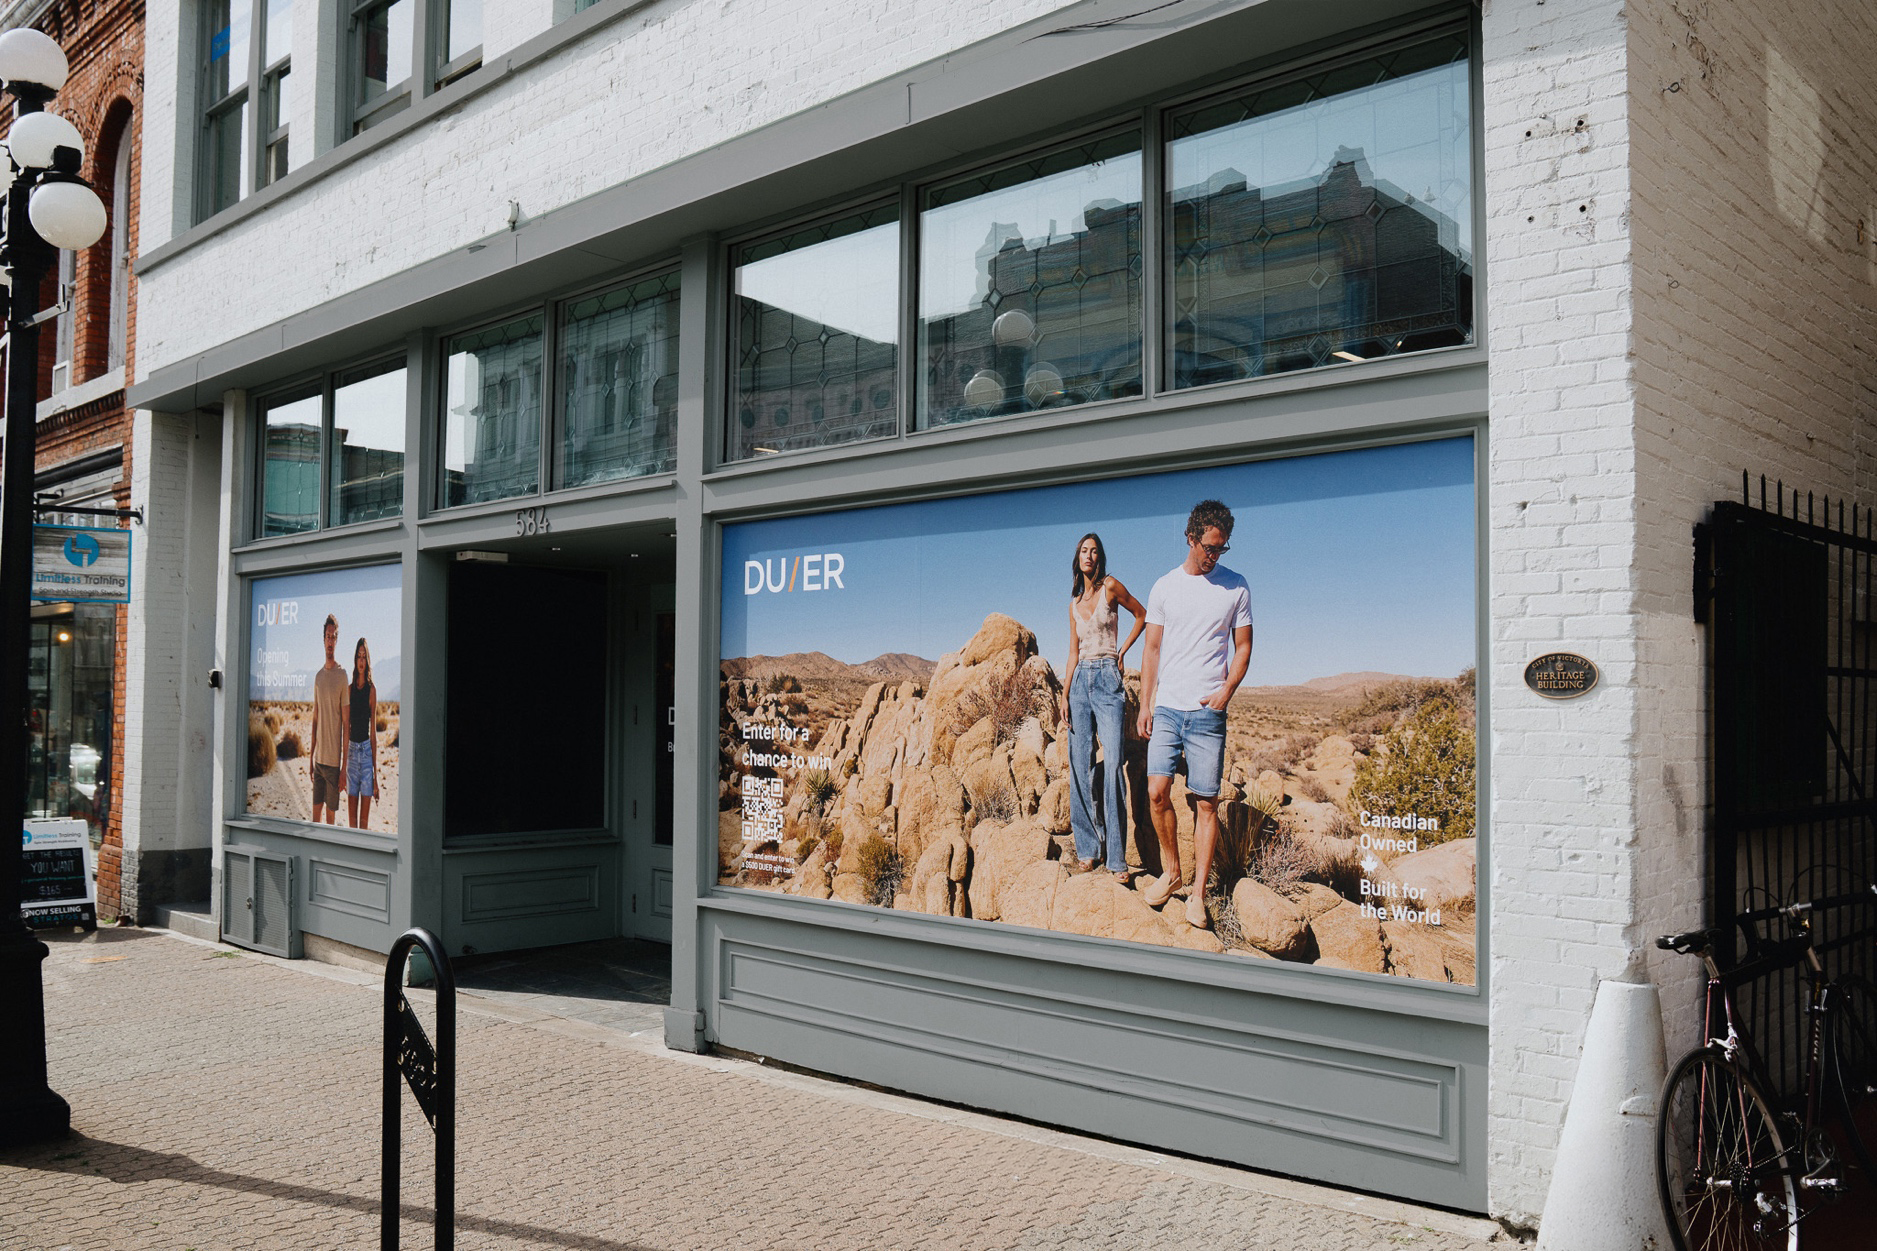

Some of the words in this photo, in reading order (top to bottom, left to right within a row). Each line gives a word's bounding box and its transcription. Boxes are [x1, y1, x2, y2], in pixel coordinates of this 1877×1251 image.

[515, 506, 550, 536] 584
[35, 572, 81, 584] Limitless
[84, 575, 126, 587] Training
[257, 647, 289, 667] Opening
[1531, 658, 1546, 669] CITY
[1557, 655, 1589, 669] VICTORIA
[256, 671, 272, 687] this
[272, 672, 307, 687] Summer
[1536, 671, 1585, 680] HERITAGE
[1537, 681, 1584, 689] BUILDING
[742, 721, 776, 740] Enter
[779, 723, 799, 741] for
[801, 727, 809, 741] a
[742, 749, 788, 768] chance
[790, 752, 805, 769] to
[807, 752, 832, 770] win
[1360, 811, 1438, 830] Canadian
[1360, 833, 1417, 853] Owned
[741, 850, 754, 858] Scan
[30, 861, 49, 874] YOU
[50, 860, 75, 873] WANT
[774, 864, 782, 874] gift
[1360, 879, 1398, 898] Built
[1402, 882, 1428, 900] for
[50, 906, 81, 914] SELLING
[1360, 902, 1387, 920] the
[1391, 904, 1441, 925] World
[33, 914, 78, 922] STRATOS
